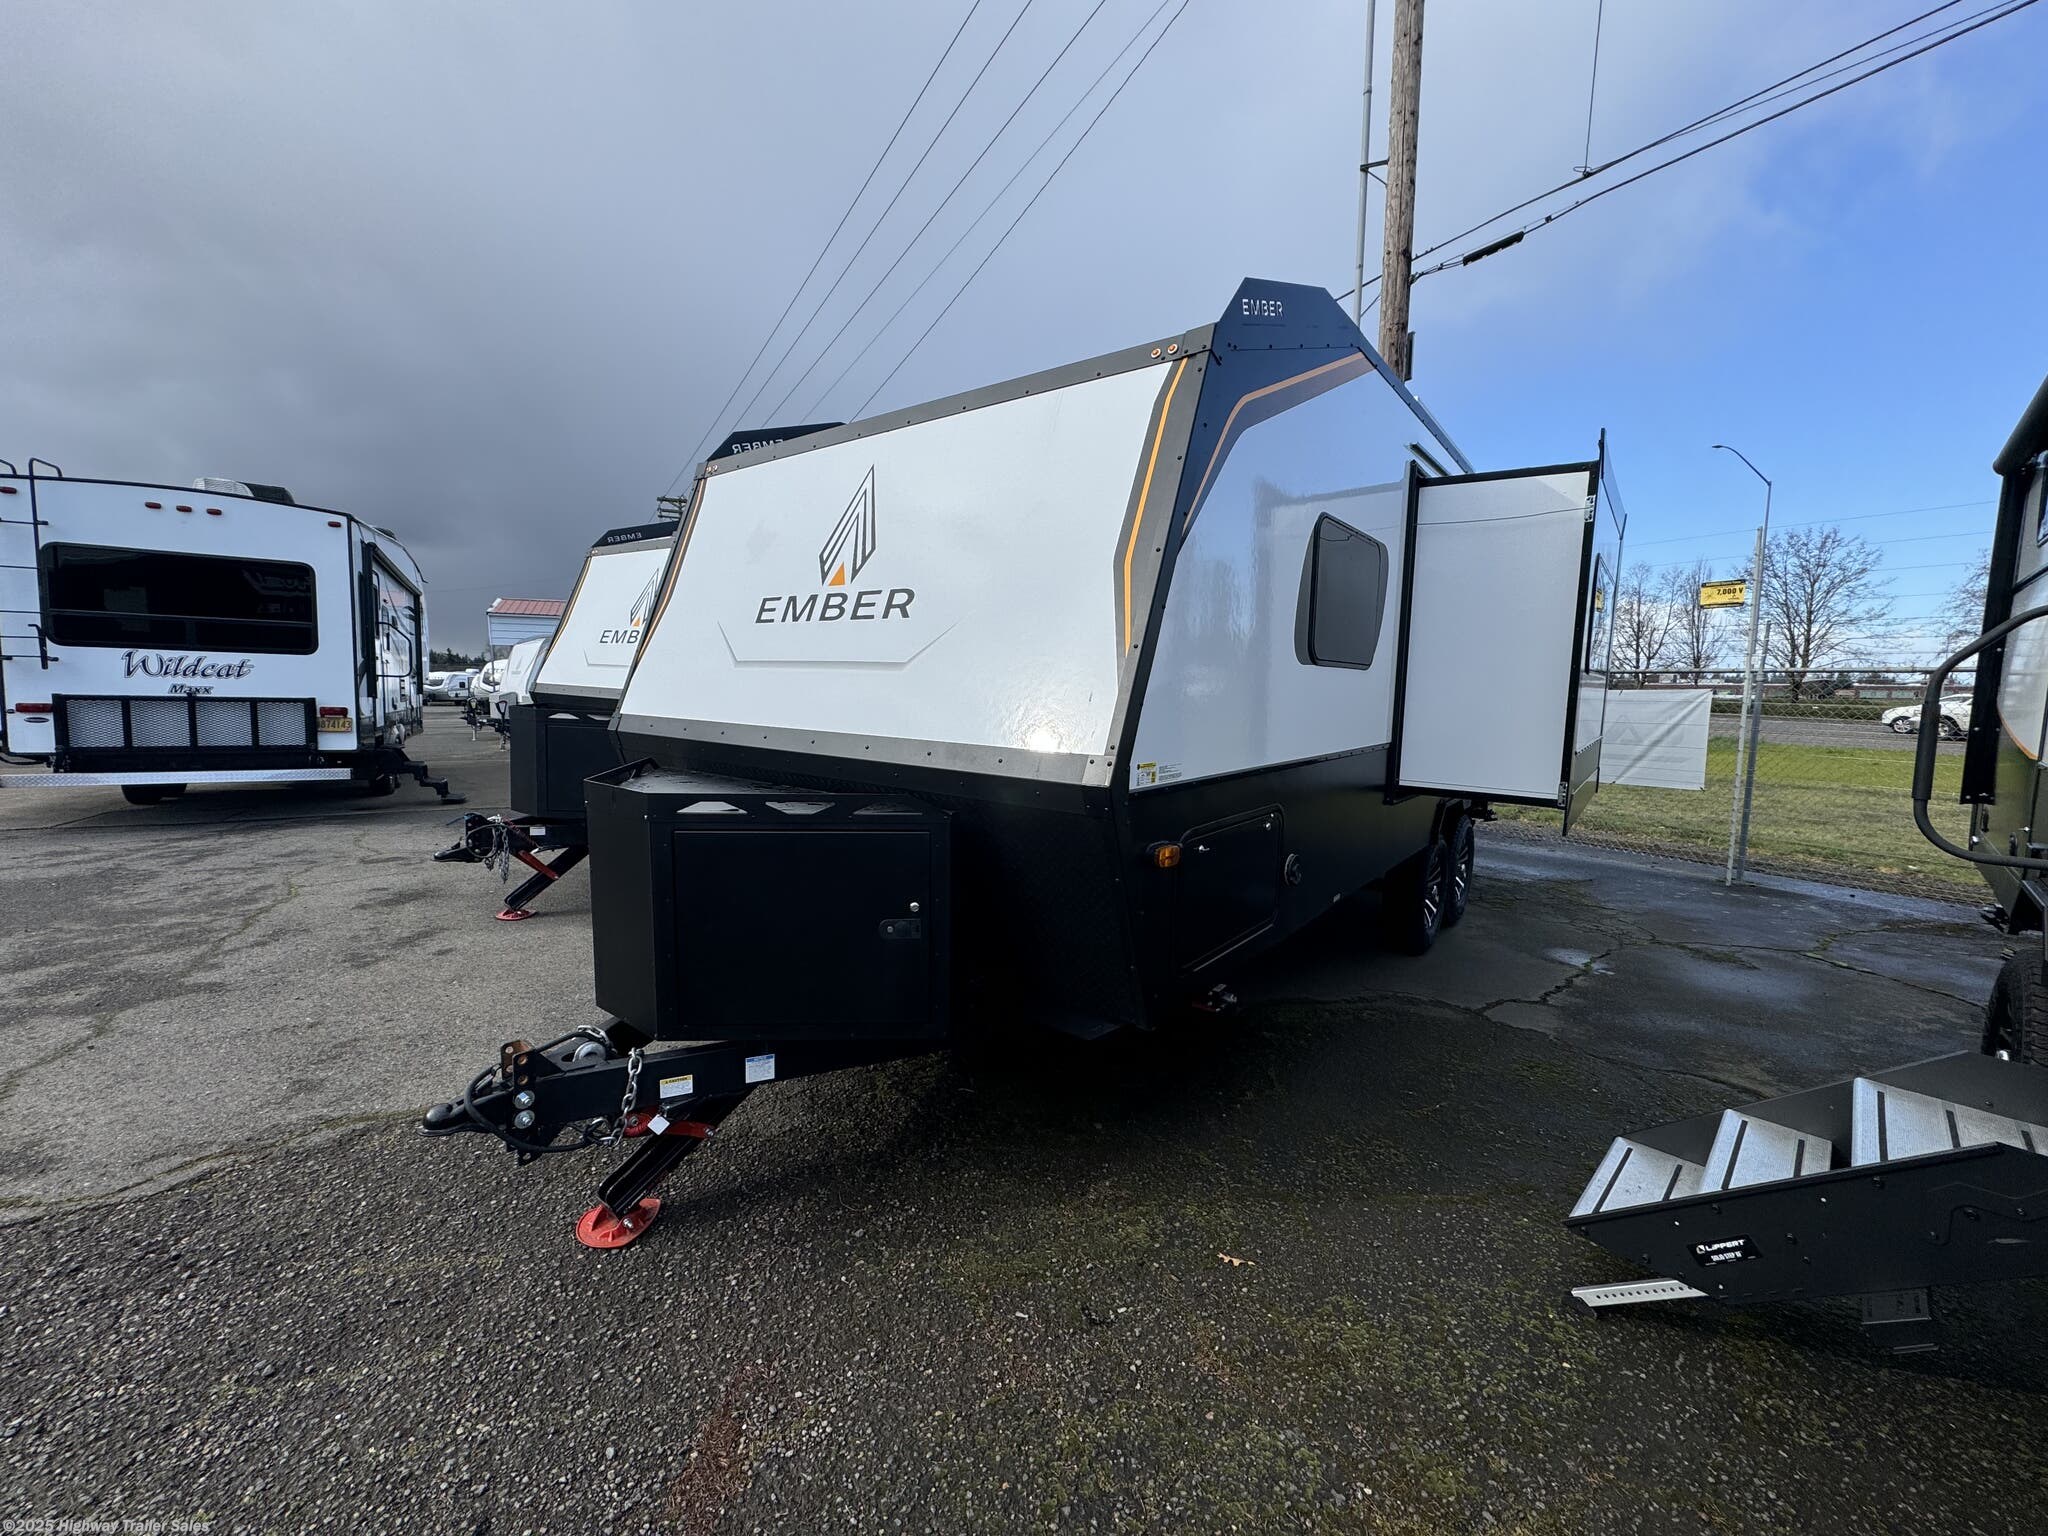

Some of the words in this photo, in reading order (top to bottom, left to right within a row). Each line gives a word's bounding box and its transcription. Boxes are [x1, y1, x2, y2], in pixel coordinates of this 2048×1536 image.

[1242, 298, 1283, 316] EMBER
[754, 587, 916, 624] EMBER
[121, 649, 255, 680] Wildcat
